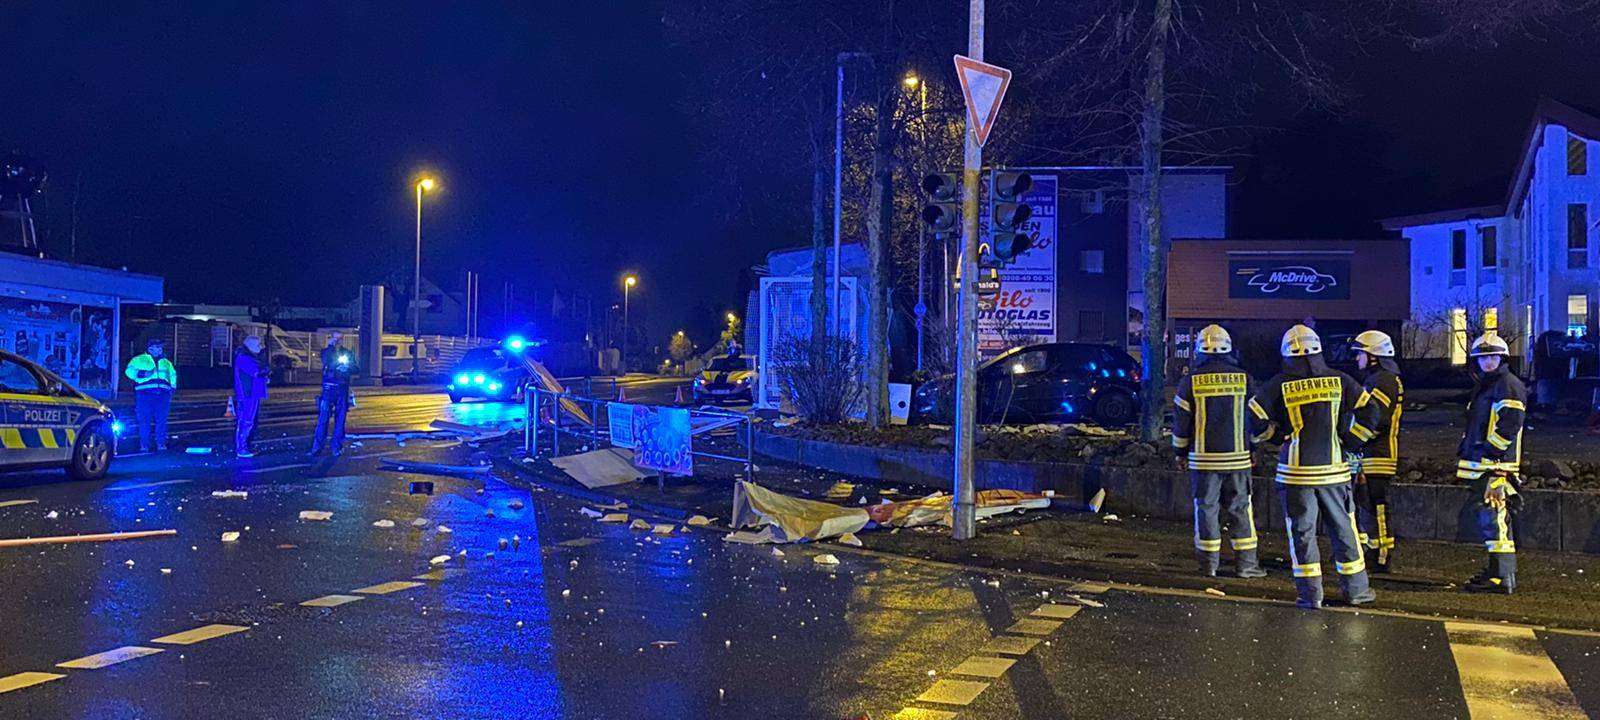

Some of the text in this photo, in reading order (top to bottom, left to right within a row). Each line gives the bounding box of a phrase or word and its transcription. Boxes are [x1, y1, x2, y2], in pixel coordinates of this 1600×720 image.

[1269, 272, 1317, 283] McDrive
[978, 310, 1050, 320] UTOGLAS
[1193, 374, 1245, 384] FEUERWEHR
[1283, 377, 1340, 393] FEUERWEHR
[25, 409, 61, 422] POLIZEI
